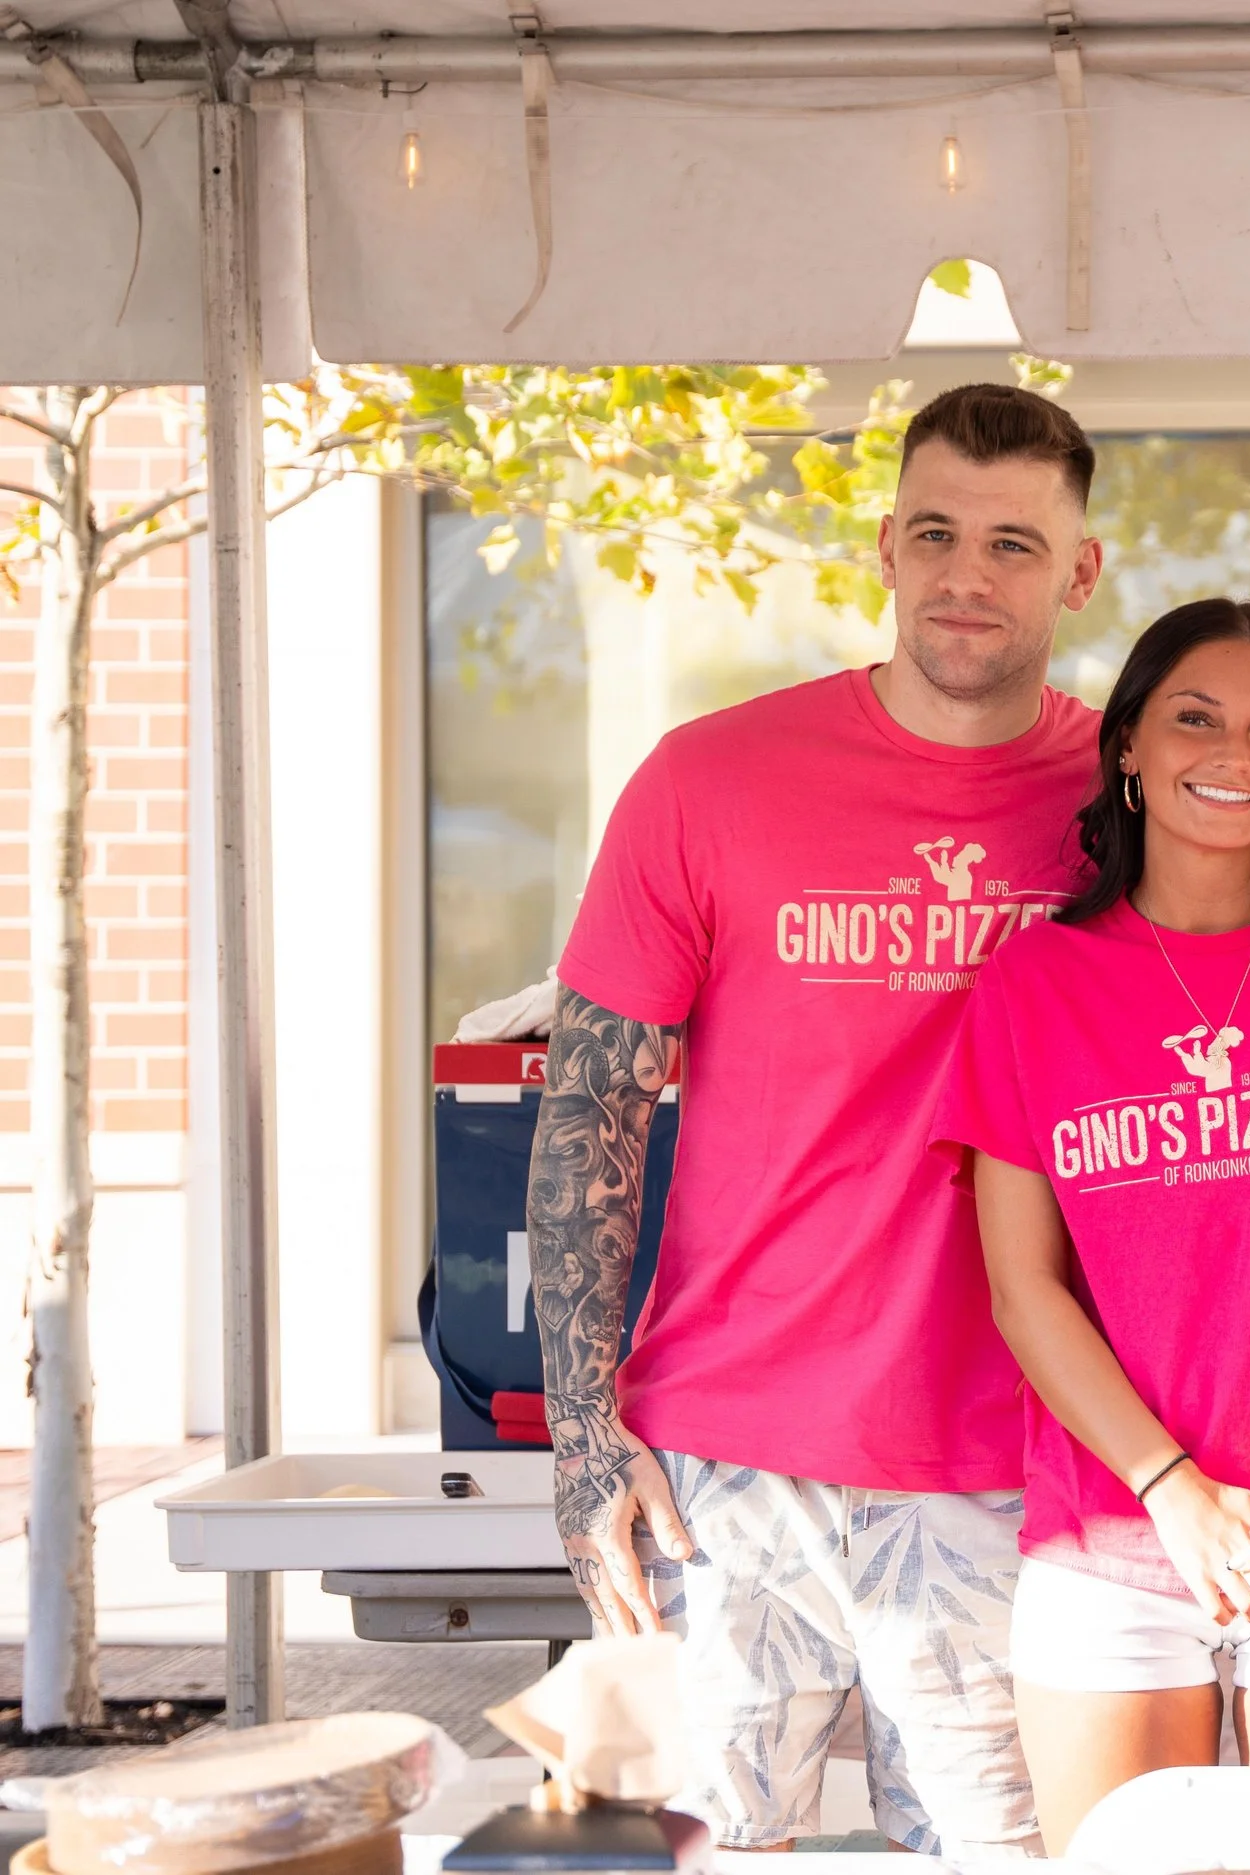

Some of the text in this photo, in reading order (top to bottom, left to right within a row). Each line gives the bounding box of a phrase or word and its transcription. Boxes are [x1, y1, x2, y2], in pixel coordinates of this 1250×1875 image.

[888, 877, 1009, 896] SINCE 1976
[776, 902, 913, 965] GINO'S
[888, 971, 906, 991] OF
[1170, 1082, 1197, 1095] SINCE
[1052, 1101, 1187, 1178] GINO'S
[1164, 1166, 1181, 1186] OF
